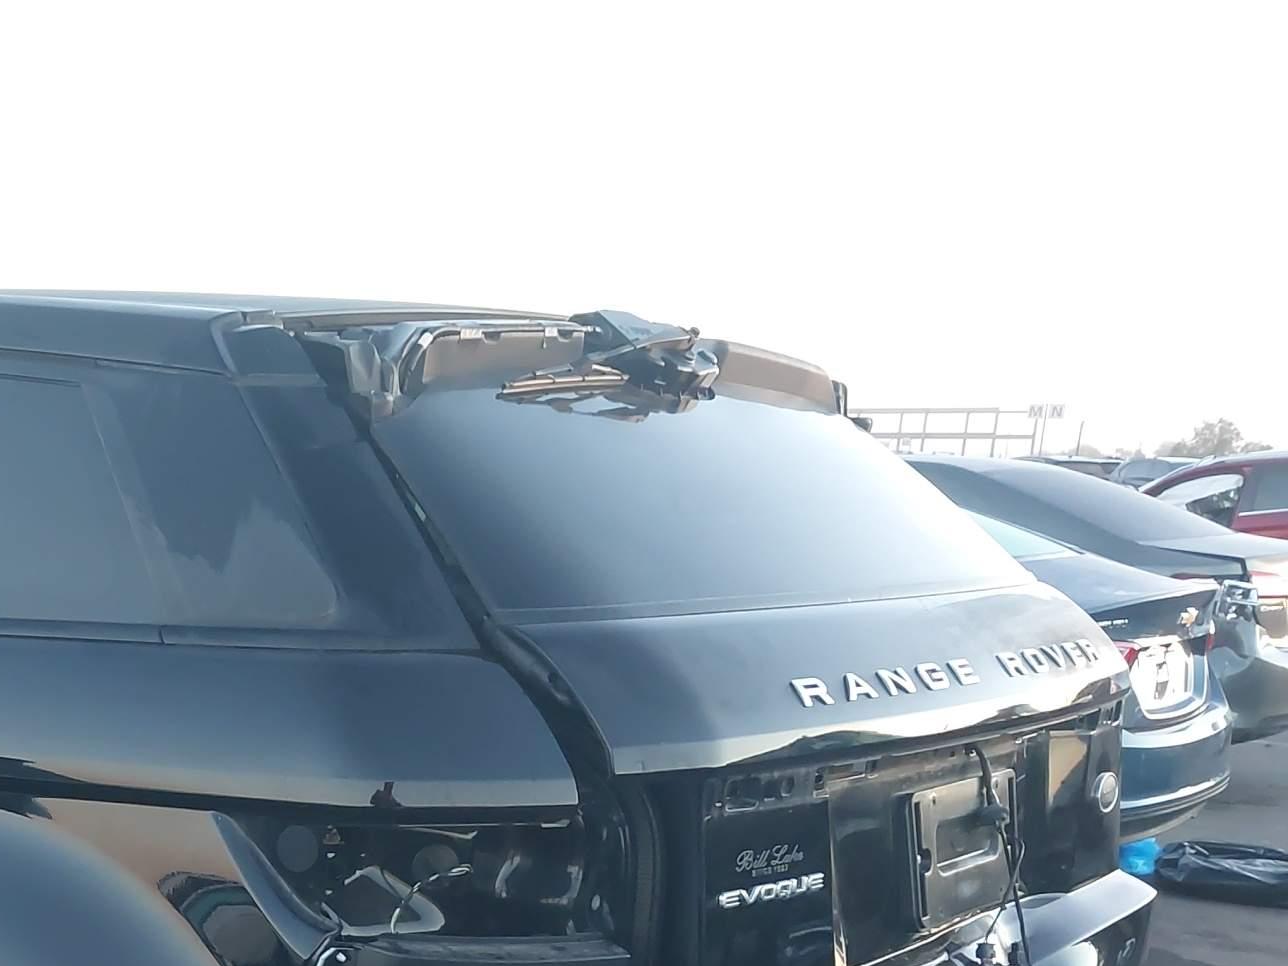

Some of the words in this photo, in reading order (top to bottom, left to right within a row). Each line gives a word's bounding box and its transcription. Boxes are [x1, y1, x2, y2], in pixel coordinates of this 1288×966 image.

[1028, 405, 1043, 418] M
[1051, 405, 1064, 418] N
[791, 657, 981, 708] RANGE
[994, 638, 1099, 678] ROVER
[735, 850, 770, 872] Bill
[717, 872, 825, 909] EVOQUE
